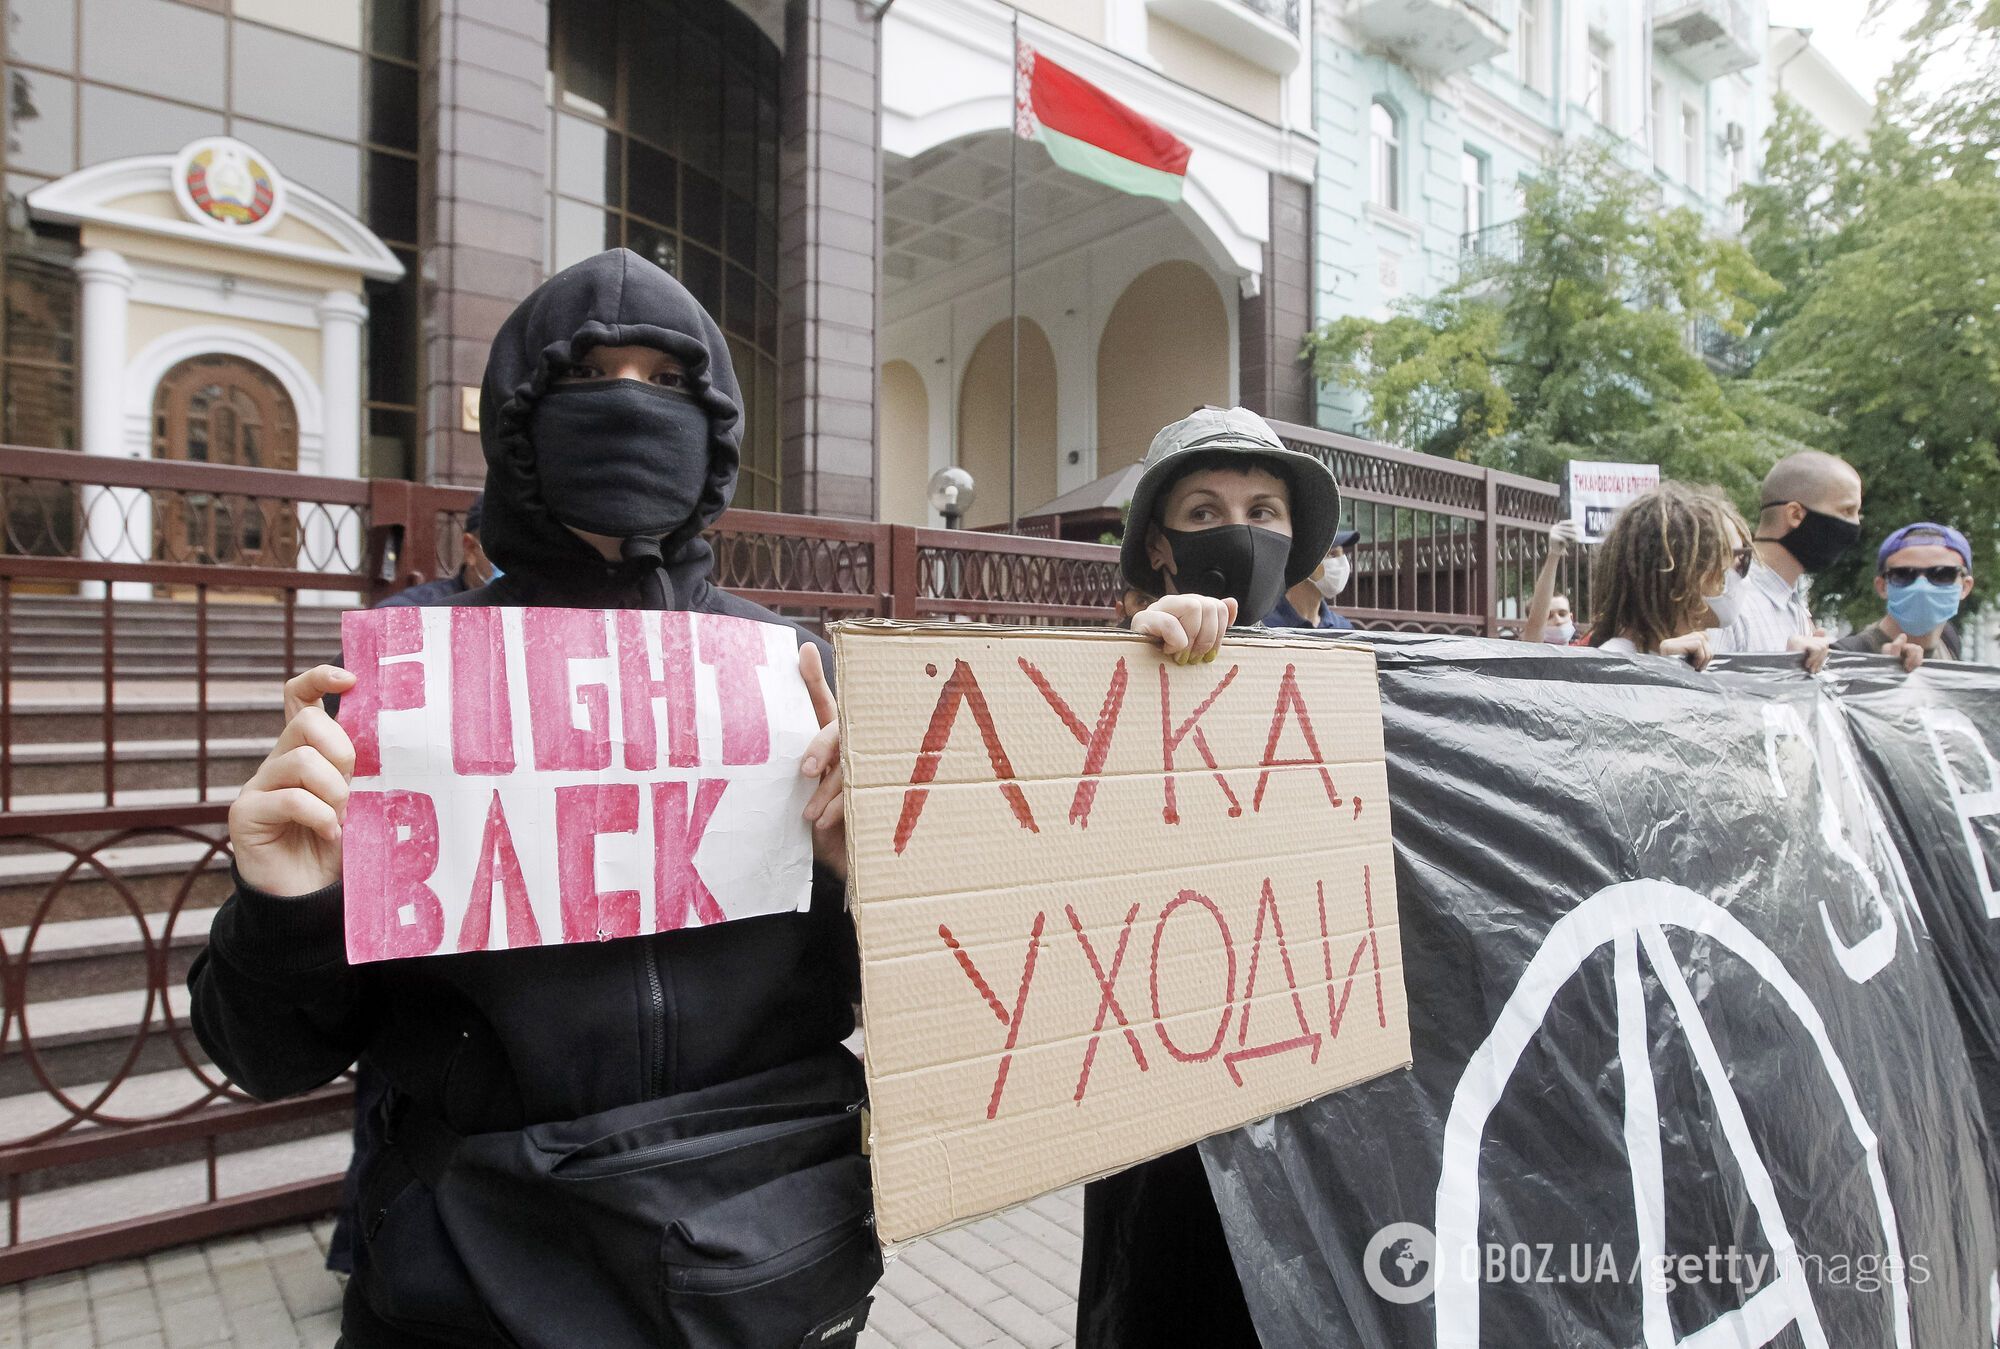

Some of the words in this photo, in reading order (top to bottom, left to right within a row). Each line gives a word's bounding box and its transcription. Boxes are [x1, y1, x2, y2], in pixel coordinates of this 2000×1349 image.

[343, 606, 771, 776] FIGHT
[894, 656, 1363, 857] ЛУКА,
[344, 778, 731, 964] BACK
[938, 864, 1387, 1120] УХОДИ
